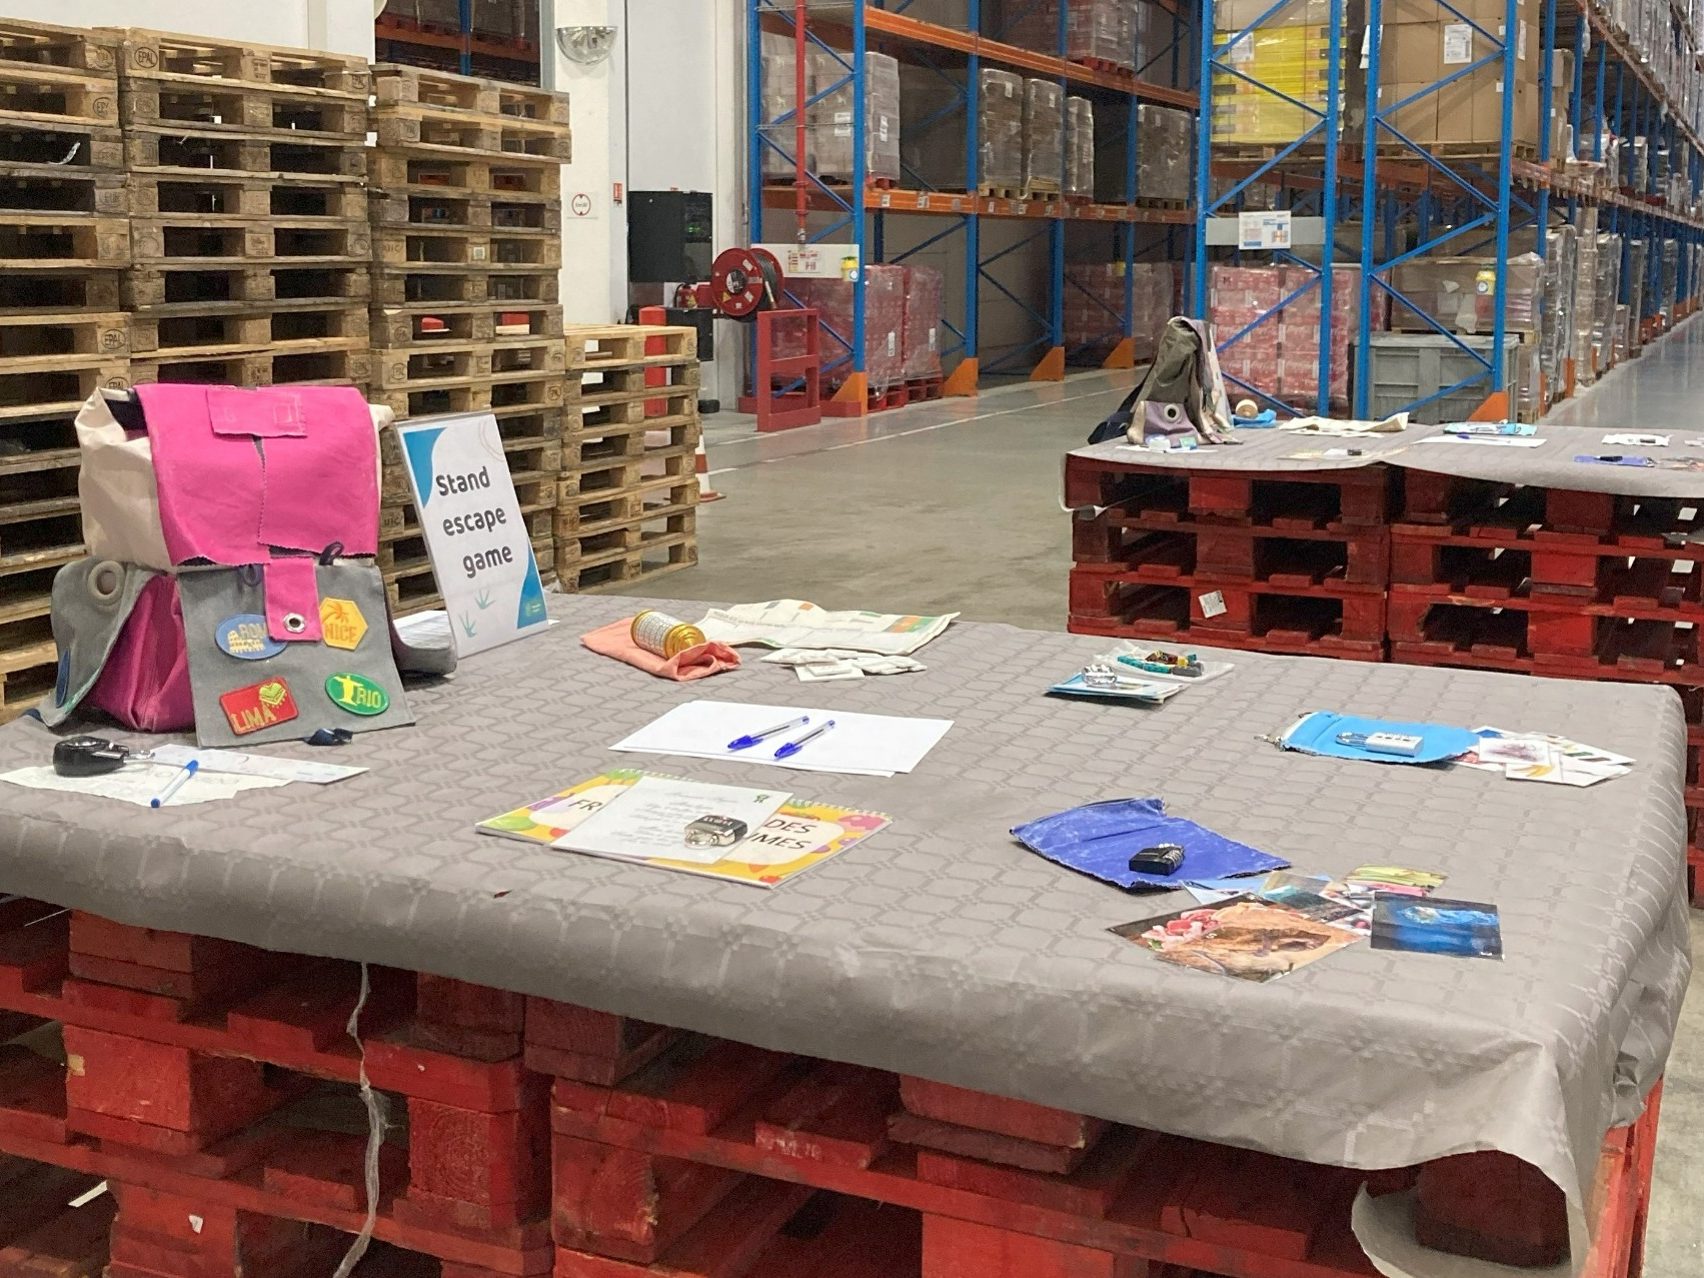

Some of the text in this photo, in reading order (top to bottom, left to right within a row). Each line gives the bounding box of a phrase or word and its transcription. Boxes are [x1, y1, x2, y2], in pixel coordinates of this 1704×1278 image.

[138, 51, 154, 64] EPAL
[104, 334, 122, 346] EPAL
[436, 466, 491, 496] Stand
[443, 507, 507, 536] escape
[463, 545, 513, 579] game
[325, 623, 357, 643] NICE
[356, 687, 382, 708] RIO
[231, 703, 277, 733] LIMA
[764, 819, 818, 834] DES
